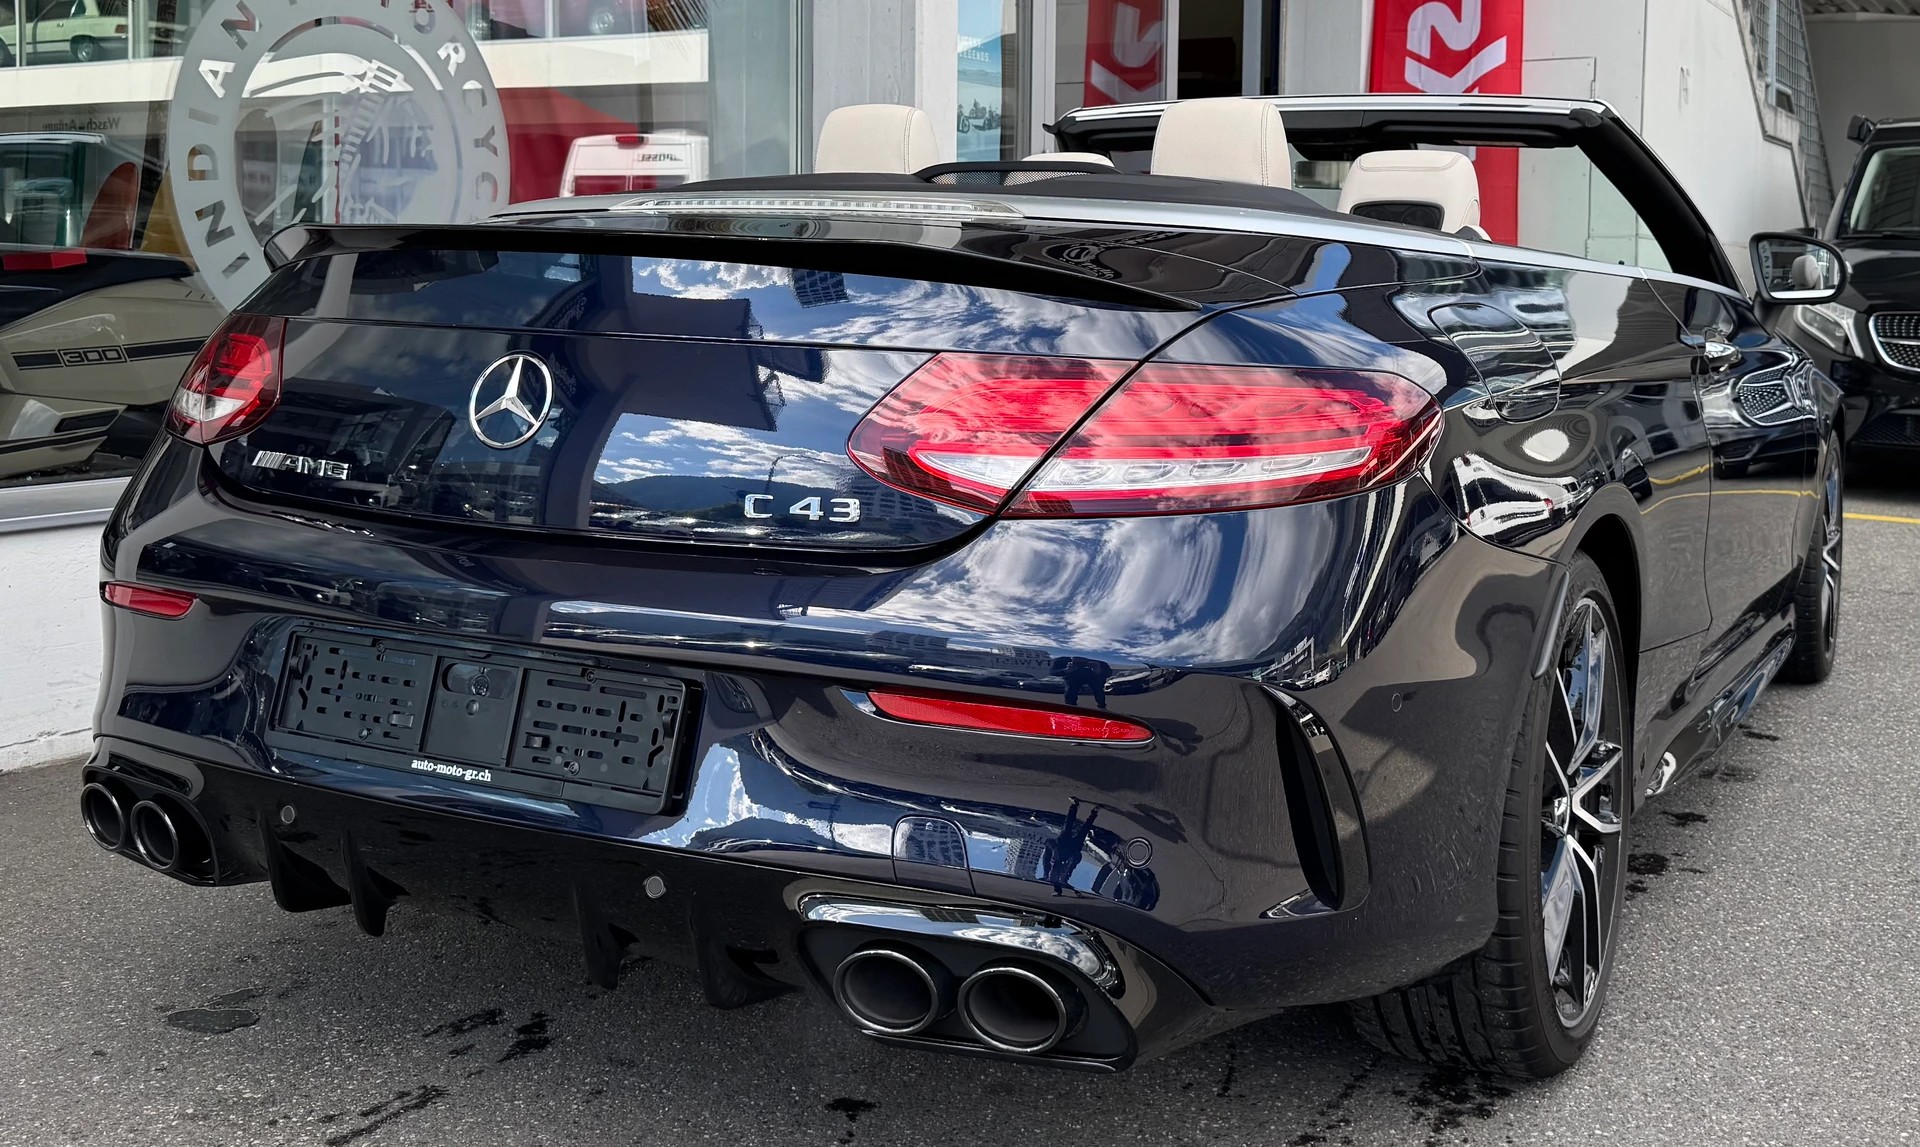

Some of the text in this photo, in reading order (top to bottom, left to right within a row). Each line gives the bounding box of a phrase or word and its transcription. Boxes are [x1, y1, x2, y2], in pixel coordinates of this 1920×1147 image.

[187, 1, 262, 280] INDIAN
[62, 349, 123, 363] 300
[744, 493, 861, 522] C 43
[411, 759, 492, 782] auto-moto-gr.ch
